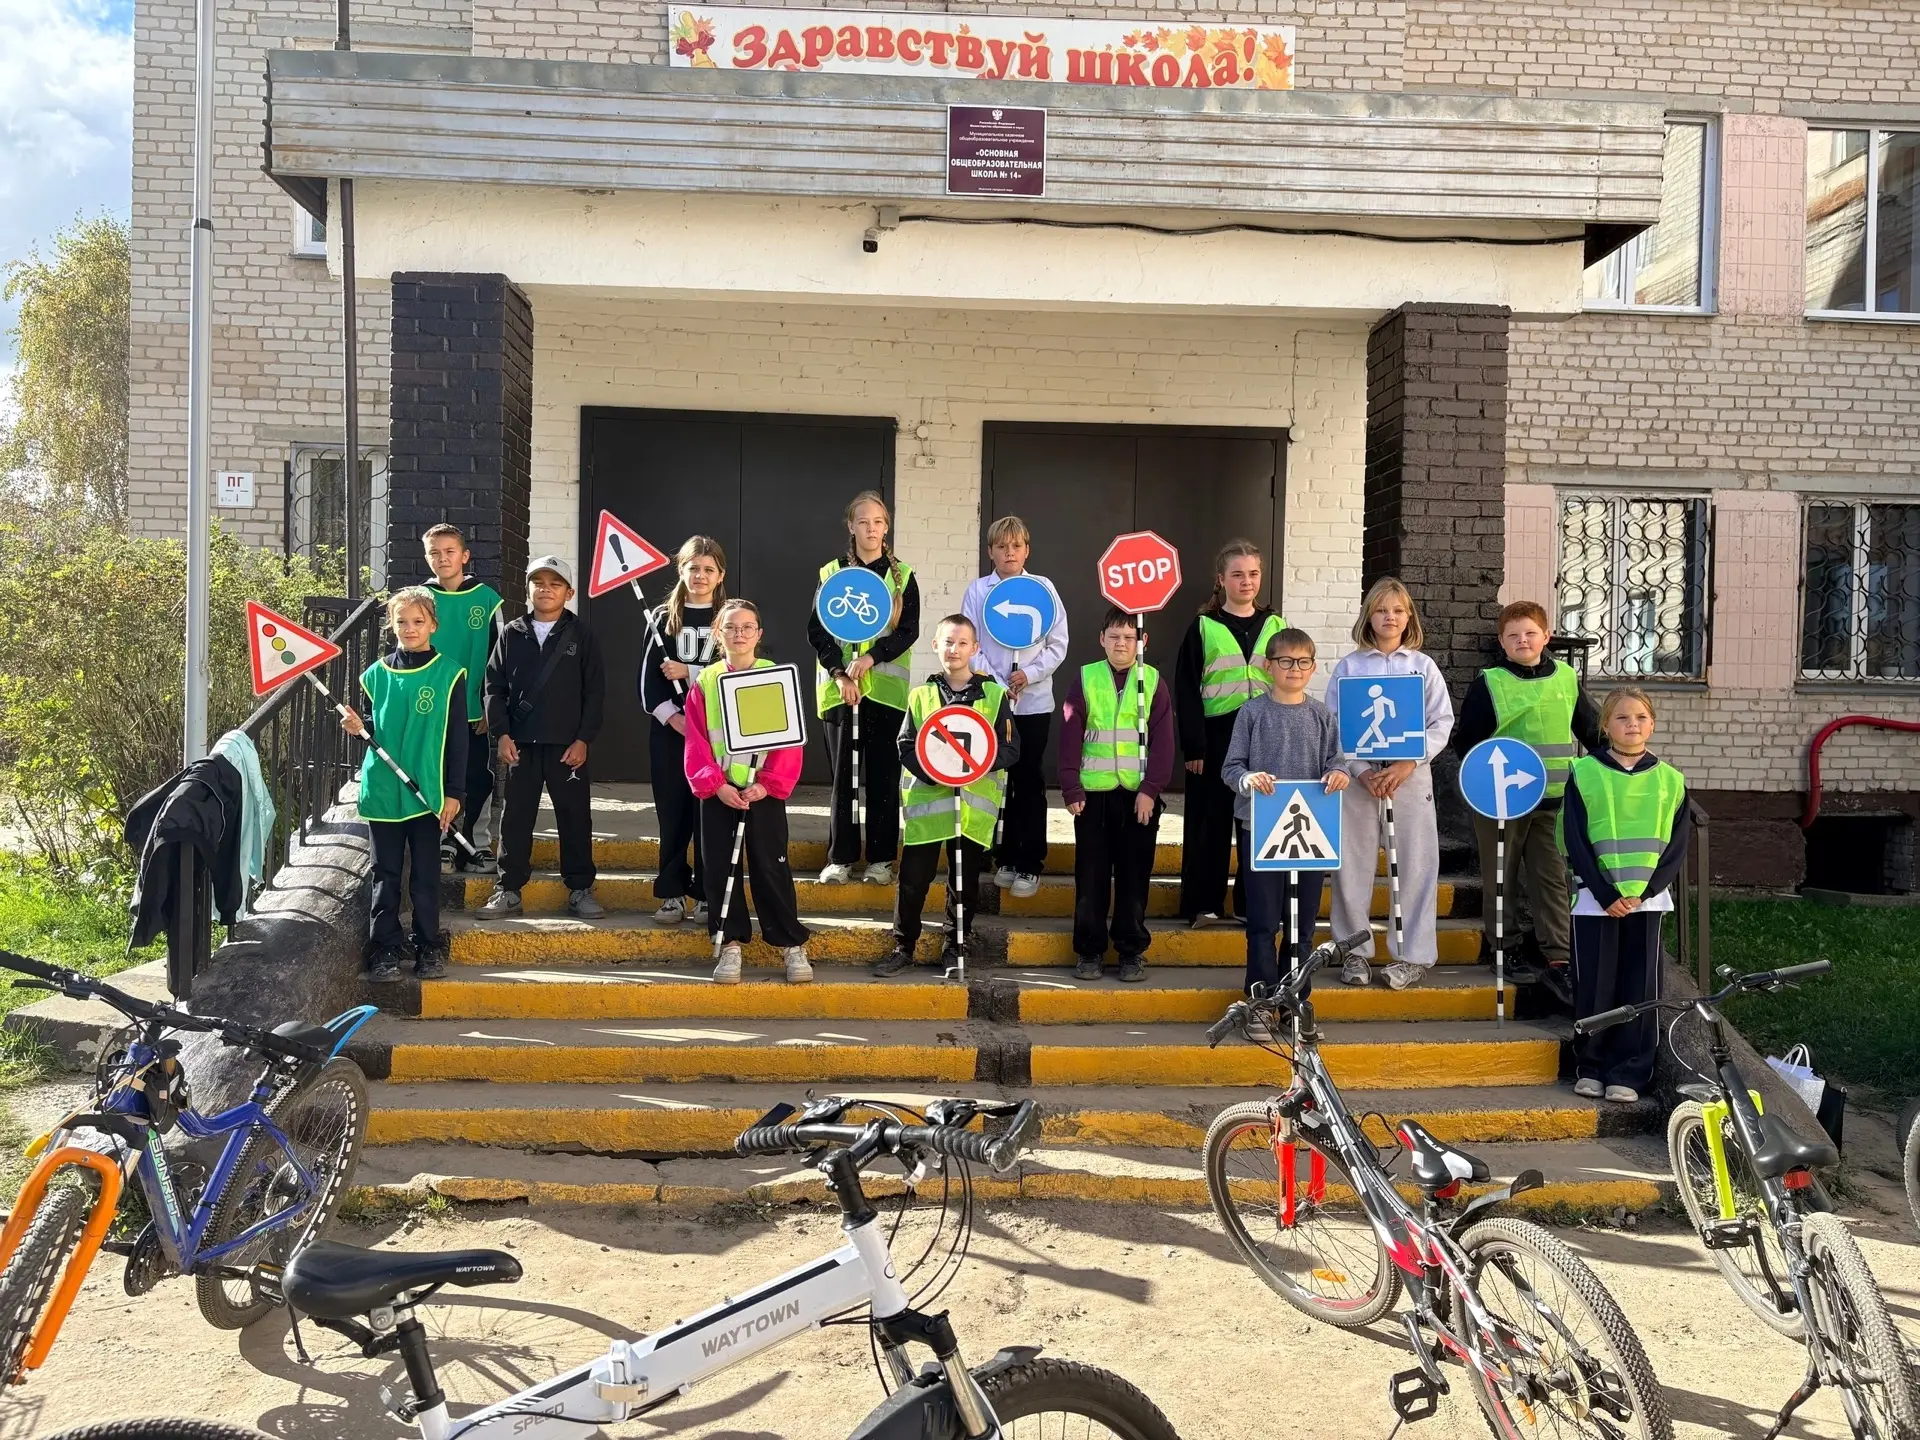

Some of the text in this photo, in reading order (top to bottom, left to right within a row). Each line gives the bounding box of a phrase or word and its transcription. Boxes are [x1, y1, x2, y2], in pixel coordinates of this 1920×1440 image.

[731, 24, 1257, 88] Здравствуй школа!
[950, 158, 1043, 169] ОБЩЕОБРАЗОВАТЕЛЬНАЯ
[975, 148, 1019, 158] «ОСНОВНАЯ
[971, 169, 1022, 179] ШКОЛА № 14»
[227, 476, 245, 487] ПГ
[1107, 557, 1172, 588] STOP
[468, 605, 486, 630] 8
[676, 626, 717, 663] 07
[415, 685, 436, 715] 8
[455, 1264, 496, 1273] WAYTOWN
[701, 1298, 800, 1358] WAYTOWN
[513, 1401, 565, 1436] SPEED
